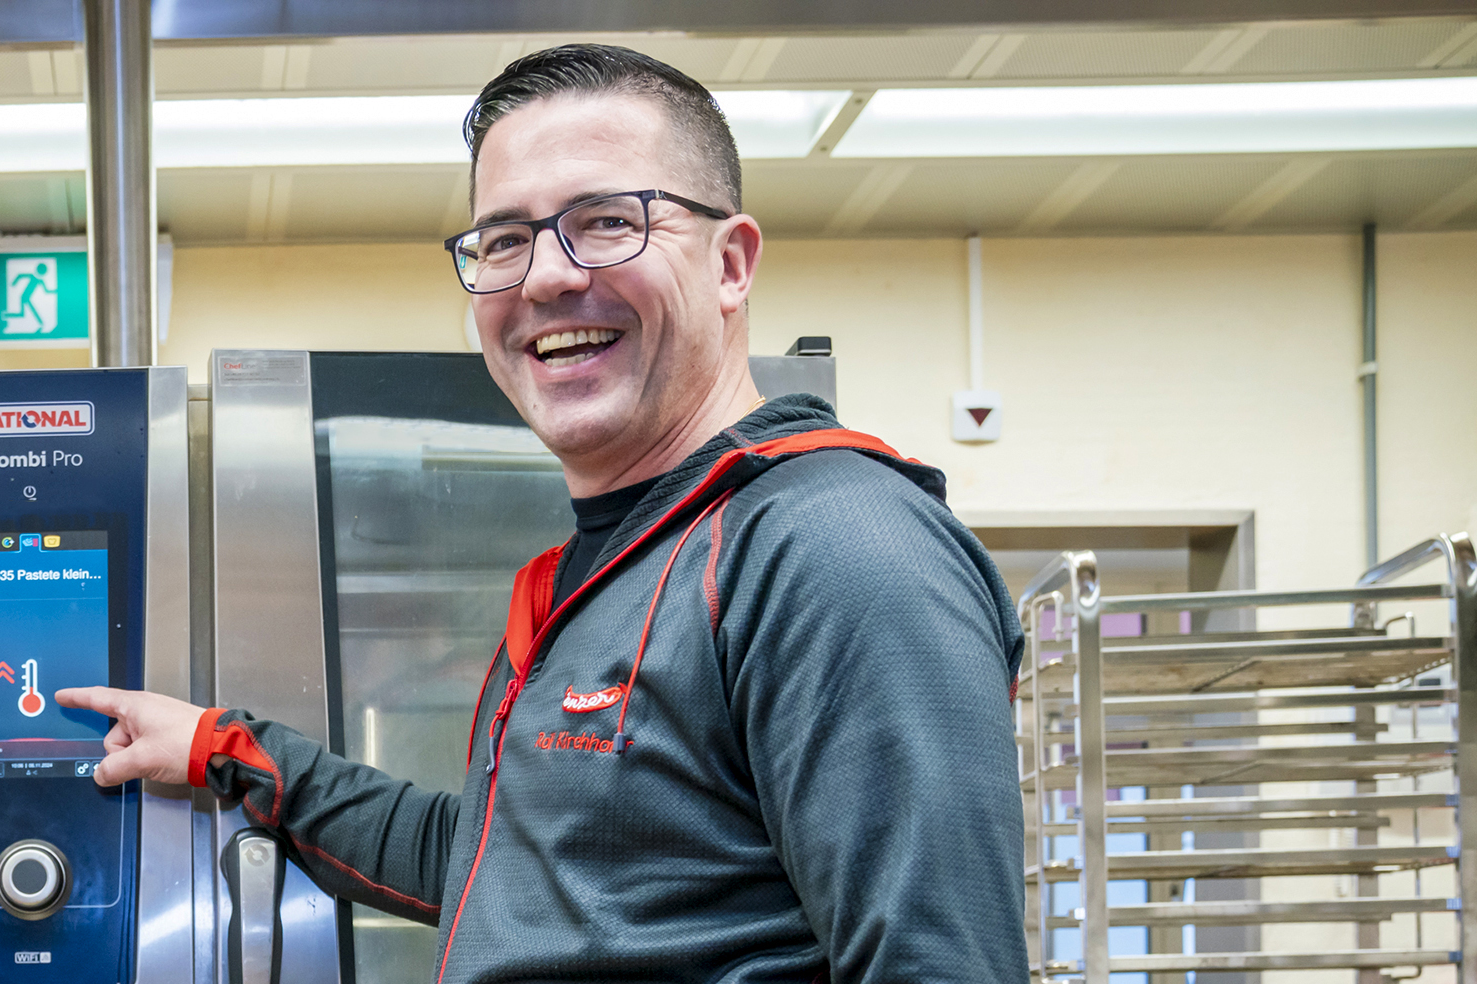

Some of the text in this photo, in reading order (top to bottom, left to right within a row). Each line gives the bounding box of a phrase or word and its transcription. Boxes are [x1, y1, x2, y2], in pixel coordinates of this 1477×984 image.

[53, 450, 83, 467] Pro
[17, 570, 60, 580] Pastete
[16, 953, 40, 962] WiFi
